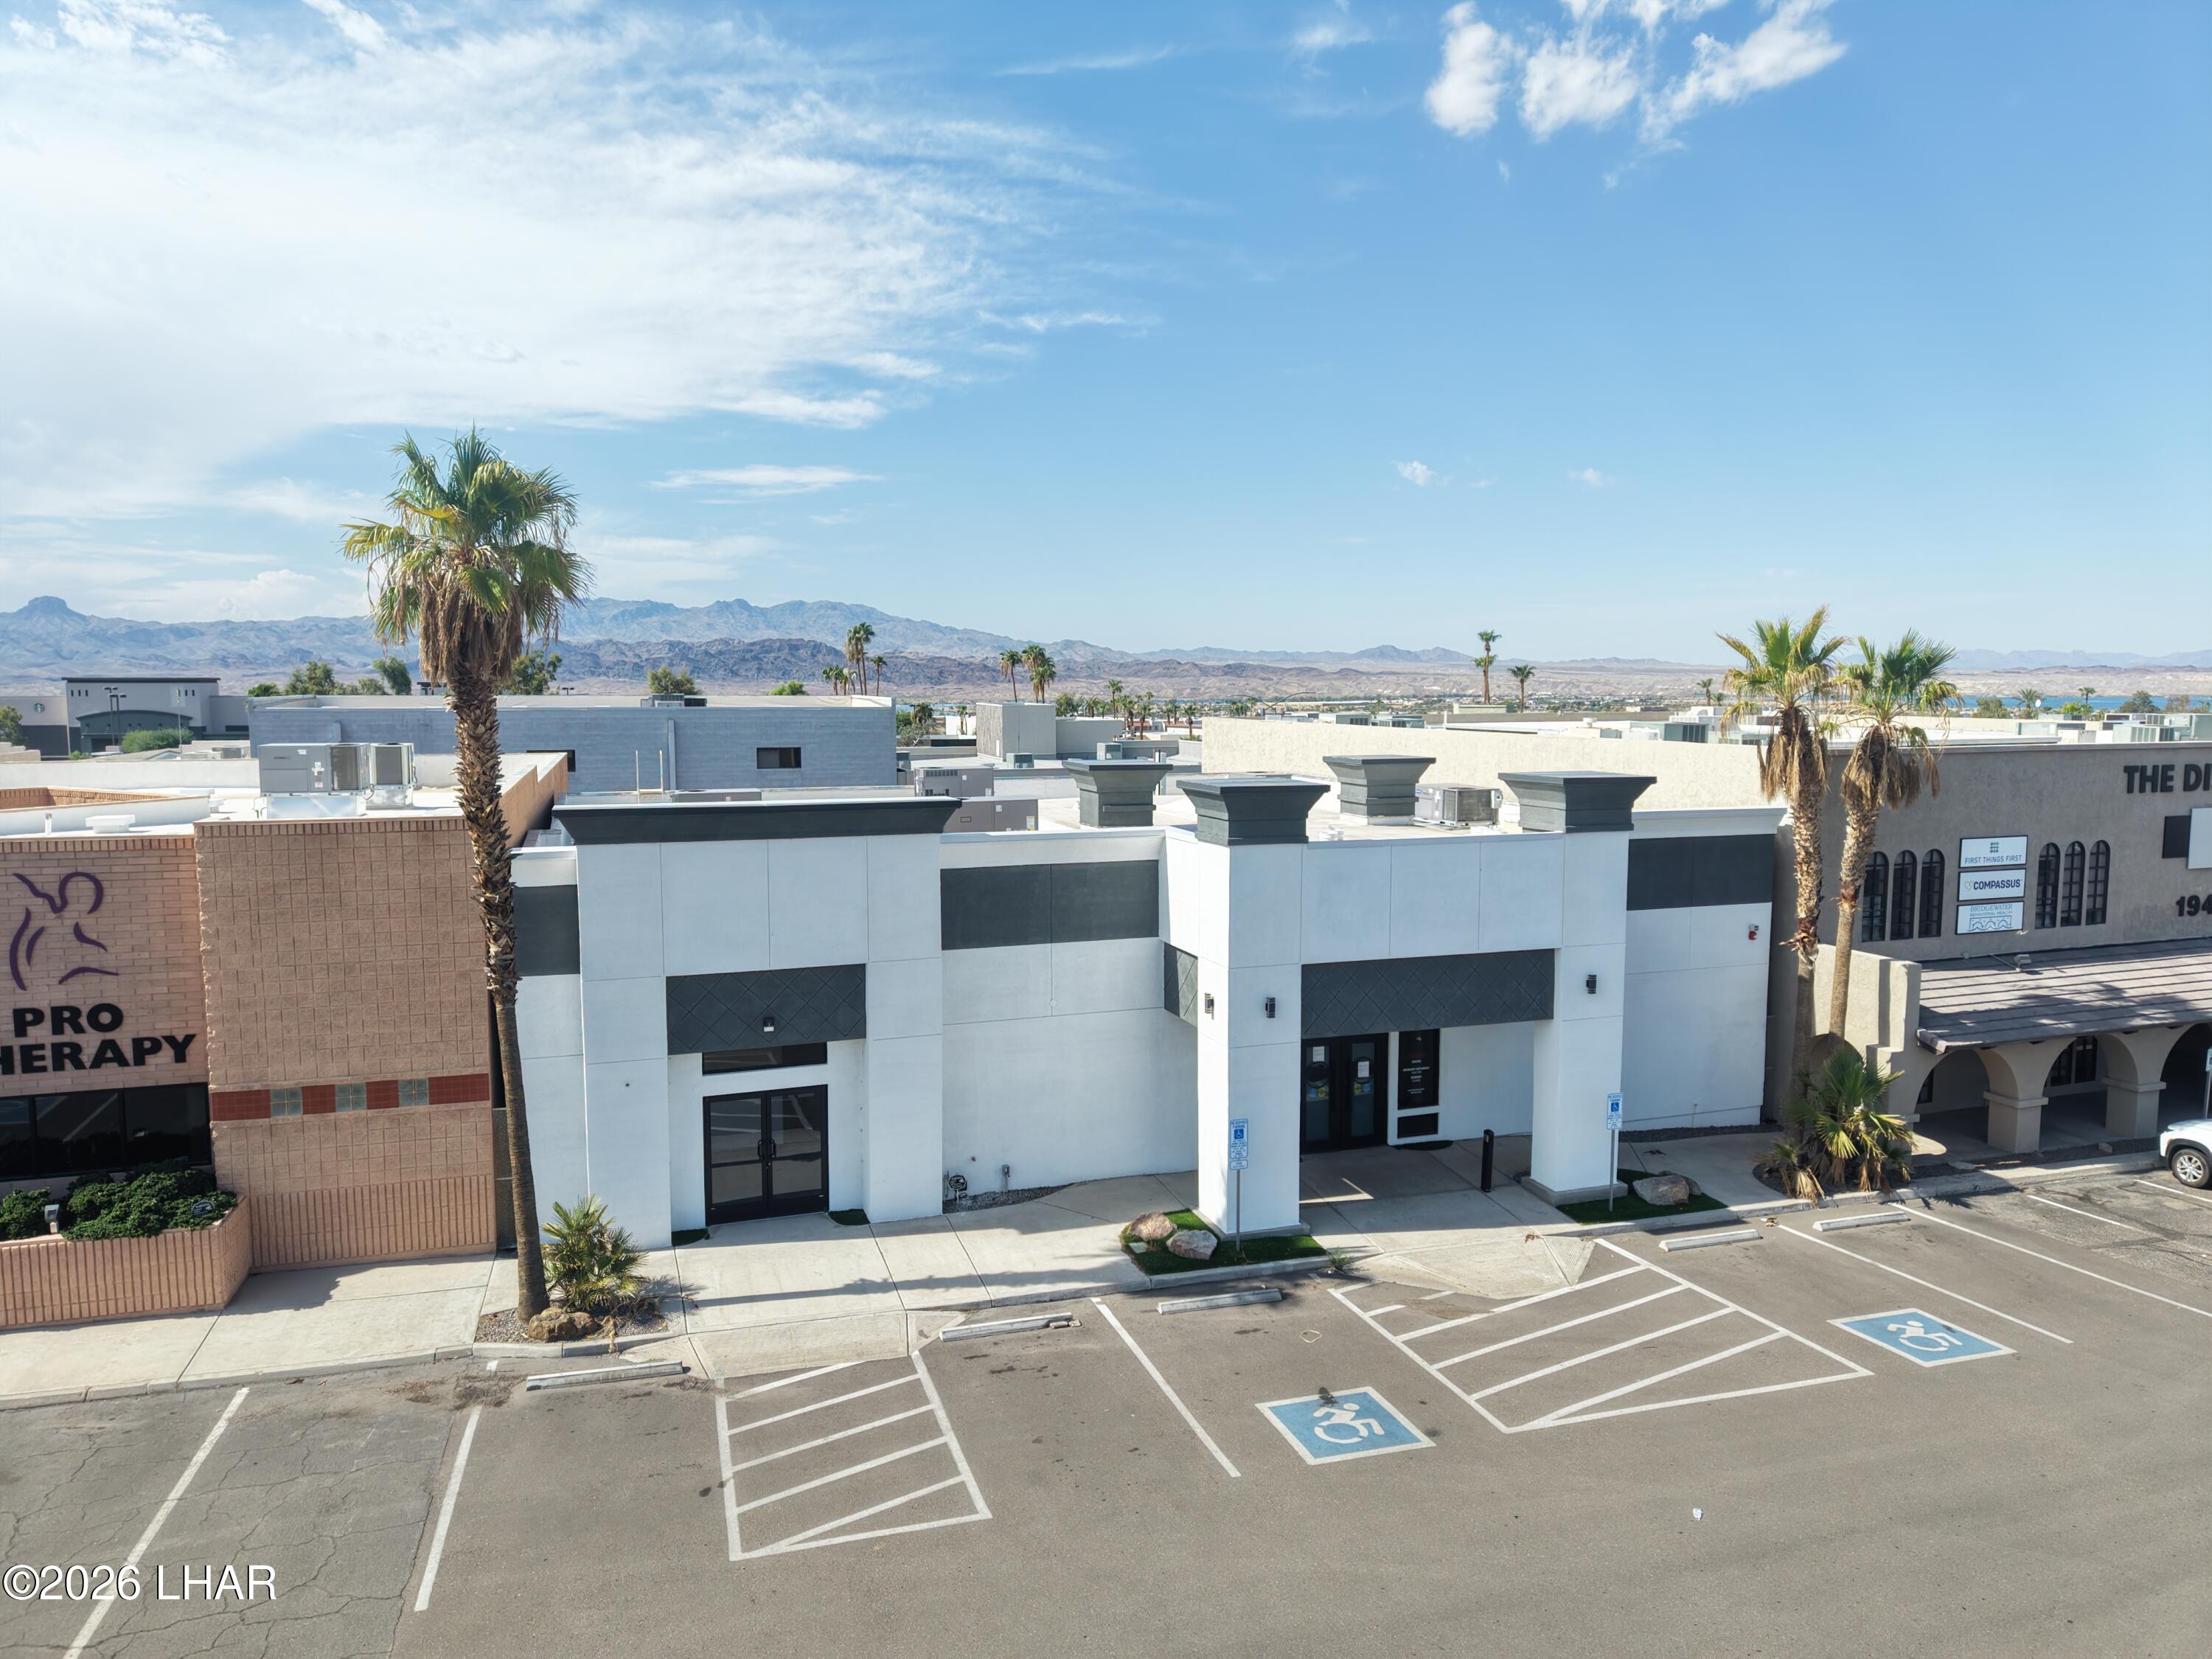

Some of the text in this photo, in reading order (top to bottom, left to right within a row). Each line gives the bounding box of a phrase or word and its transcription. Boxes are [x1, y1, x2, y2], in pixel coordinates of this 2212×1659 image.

[2124, 762, 2212, 794] THE DI
[1973, 879, 2021, 890] COMPASSUS
[1970, 904, 2012, 912] BRIDGEWATER
[12, 1003, 124, 1038] PRO
